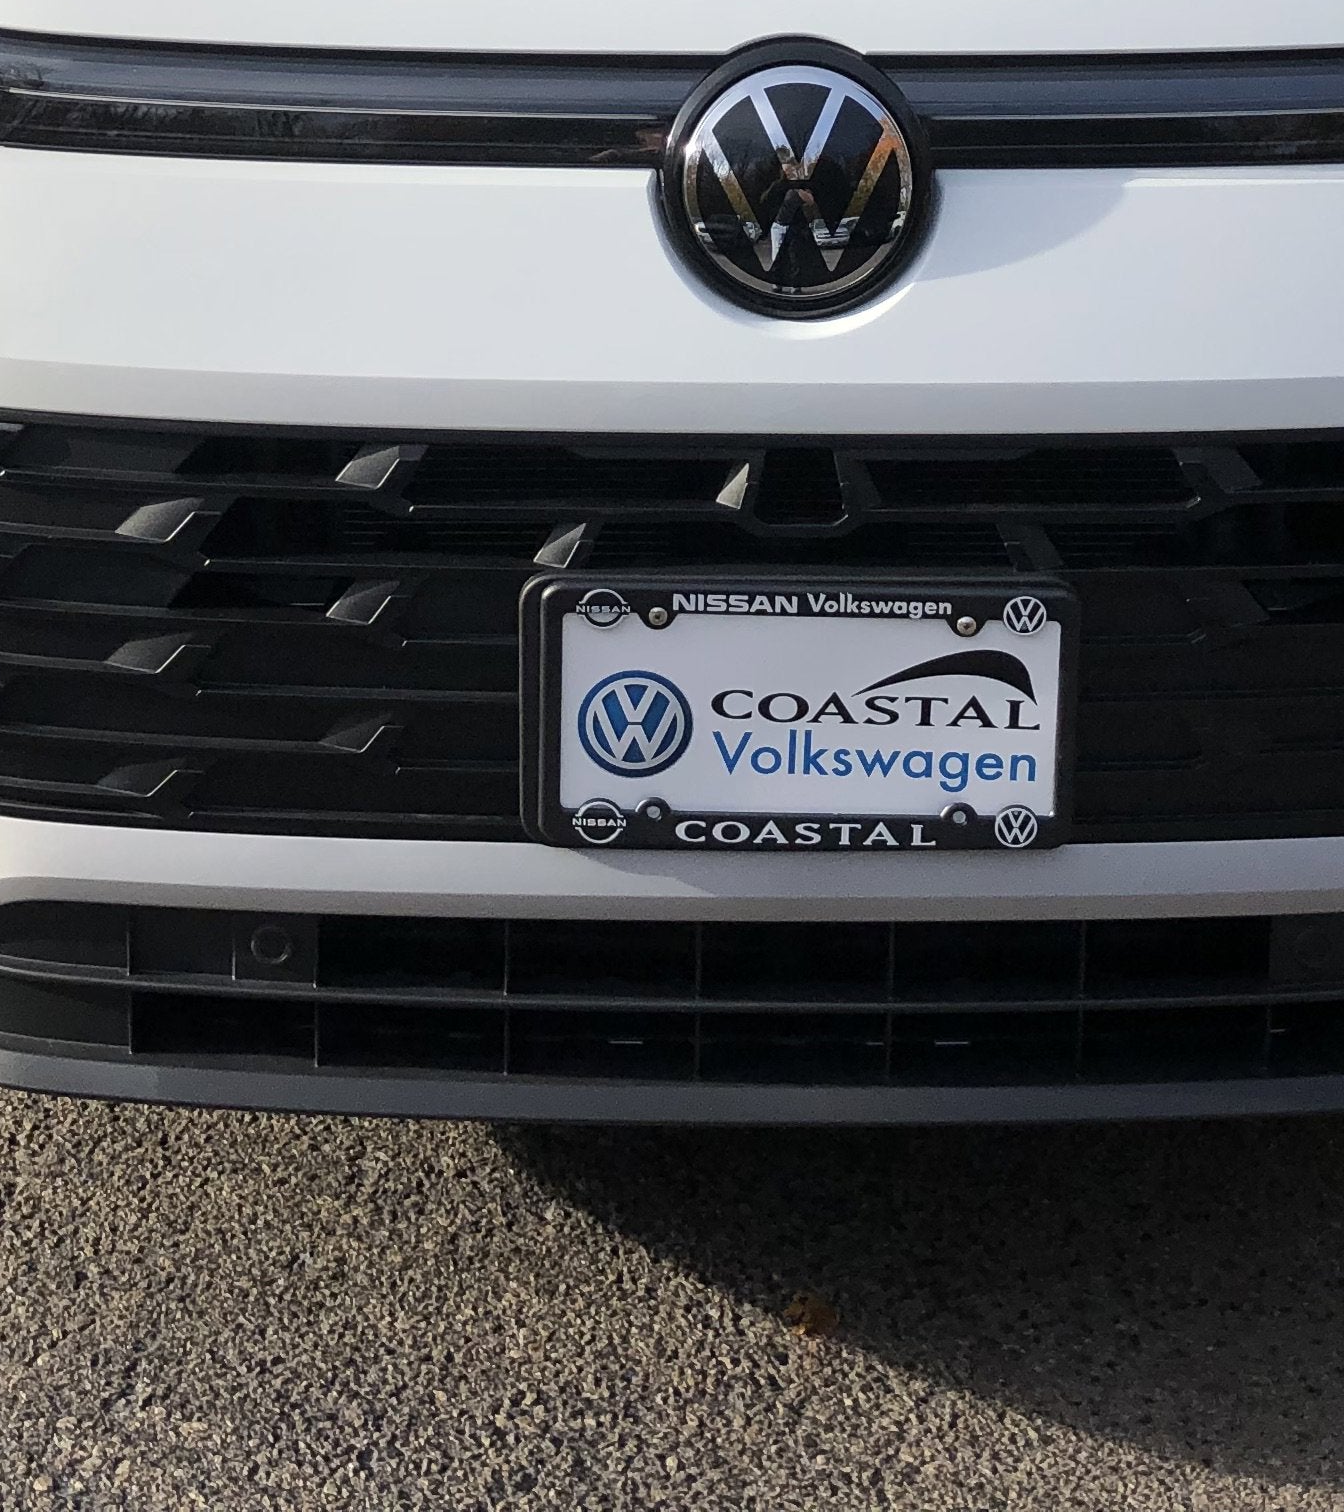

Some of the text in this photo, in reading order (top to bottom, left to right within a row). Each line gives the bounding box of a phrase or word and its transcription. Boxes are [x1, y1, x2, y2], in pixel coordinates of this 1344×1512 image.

[575, 604, 631, 614] NISSAN
[672, 593, 953, 620] NISSAN Volkswagen
[711, 689, 1041, 731] COASTAL
[712, 728, 1037, 793] Volkswagen
[572, 817, 627, 828] NISSAN
[674, 819, 937, 847] COASTAL
